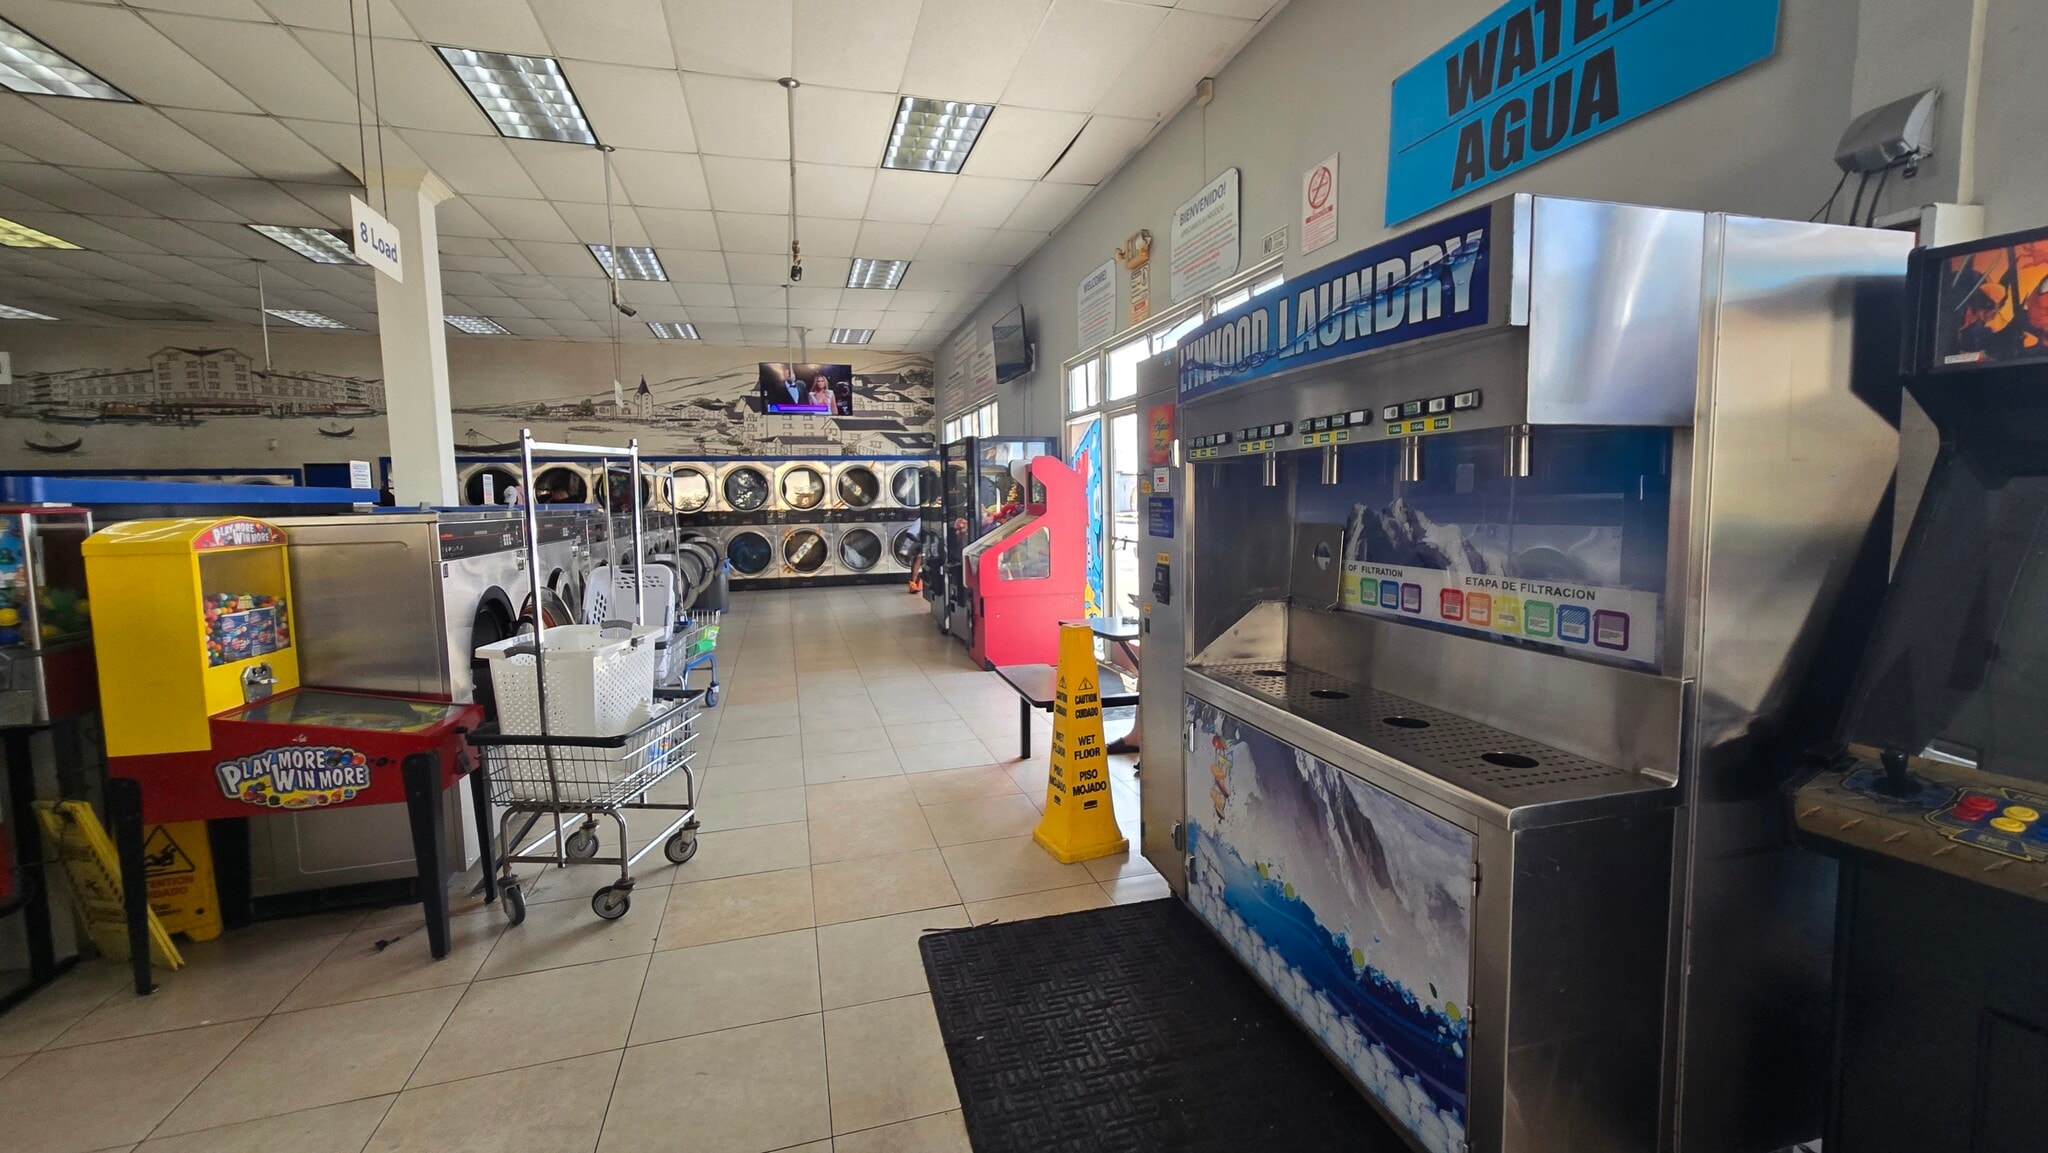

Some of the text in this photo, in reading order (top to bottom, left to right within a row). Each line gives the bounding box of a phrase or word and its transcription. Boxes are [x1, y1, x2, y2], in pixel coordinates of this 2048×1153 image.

[1451, 46, 1619, 191] AGUA
[1180, 181, 1226, 226] BIENVENIDO!
[360, 221, 398, 264] 8 Load
[1180, 308, 1268, 394] LYNWOOD
[1278, 228, 1484, 360] LAUNDRY
[212, 522, 255, 546] PLAY MORE
[233, 528, 270, 545] WIN MORE
[1348, 564, 1358, 572] OF
[1361, 565, 1403, 578] FILTRATION
[1465, 576, 1596, 601] ETAPA DE FILTRACION
[1074, 692, 1098, 705] CAUTION
[1075, 706, 1099, 719] CUIDADO
[1078, 734, 1096, 747] WET
[1074, 747, 1101, 761] FLOOR
[221, 750, 326, 793] PLAY MORE
[270, 763, 366, 792] WIN MORE
[1079, 768, 1098, 781] PISO
[1072, 780, 1107, 796] MOJADO
